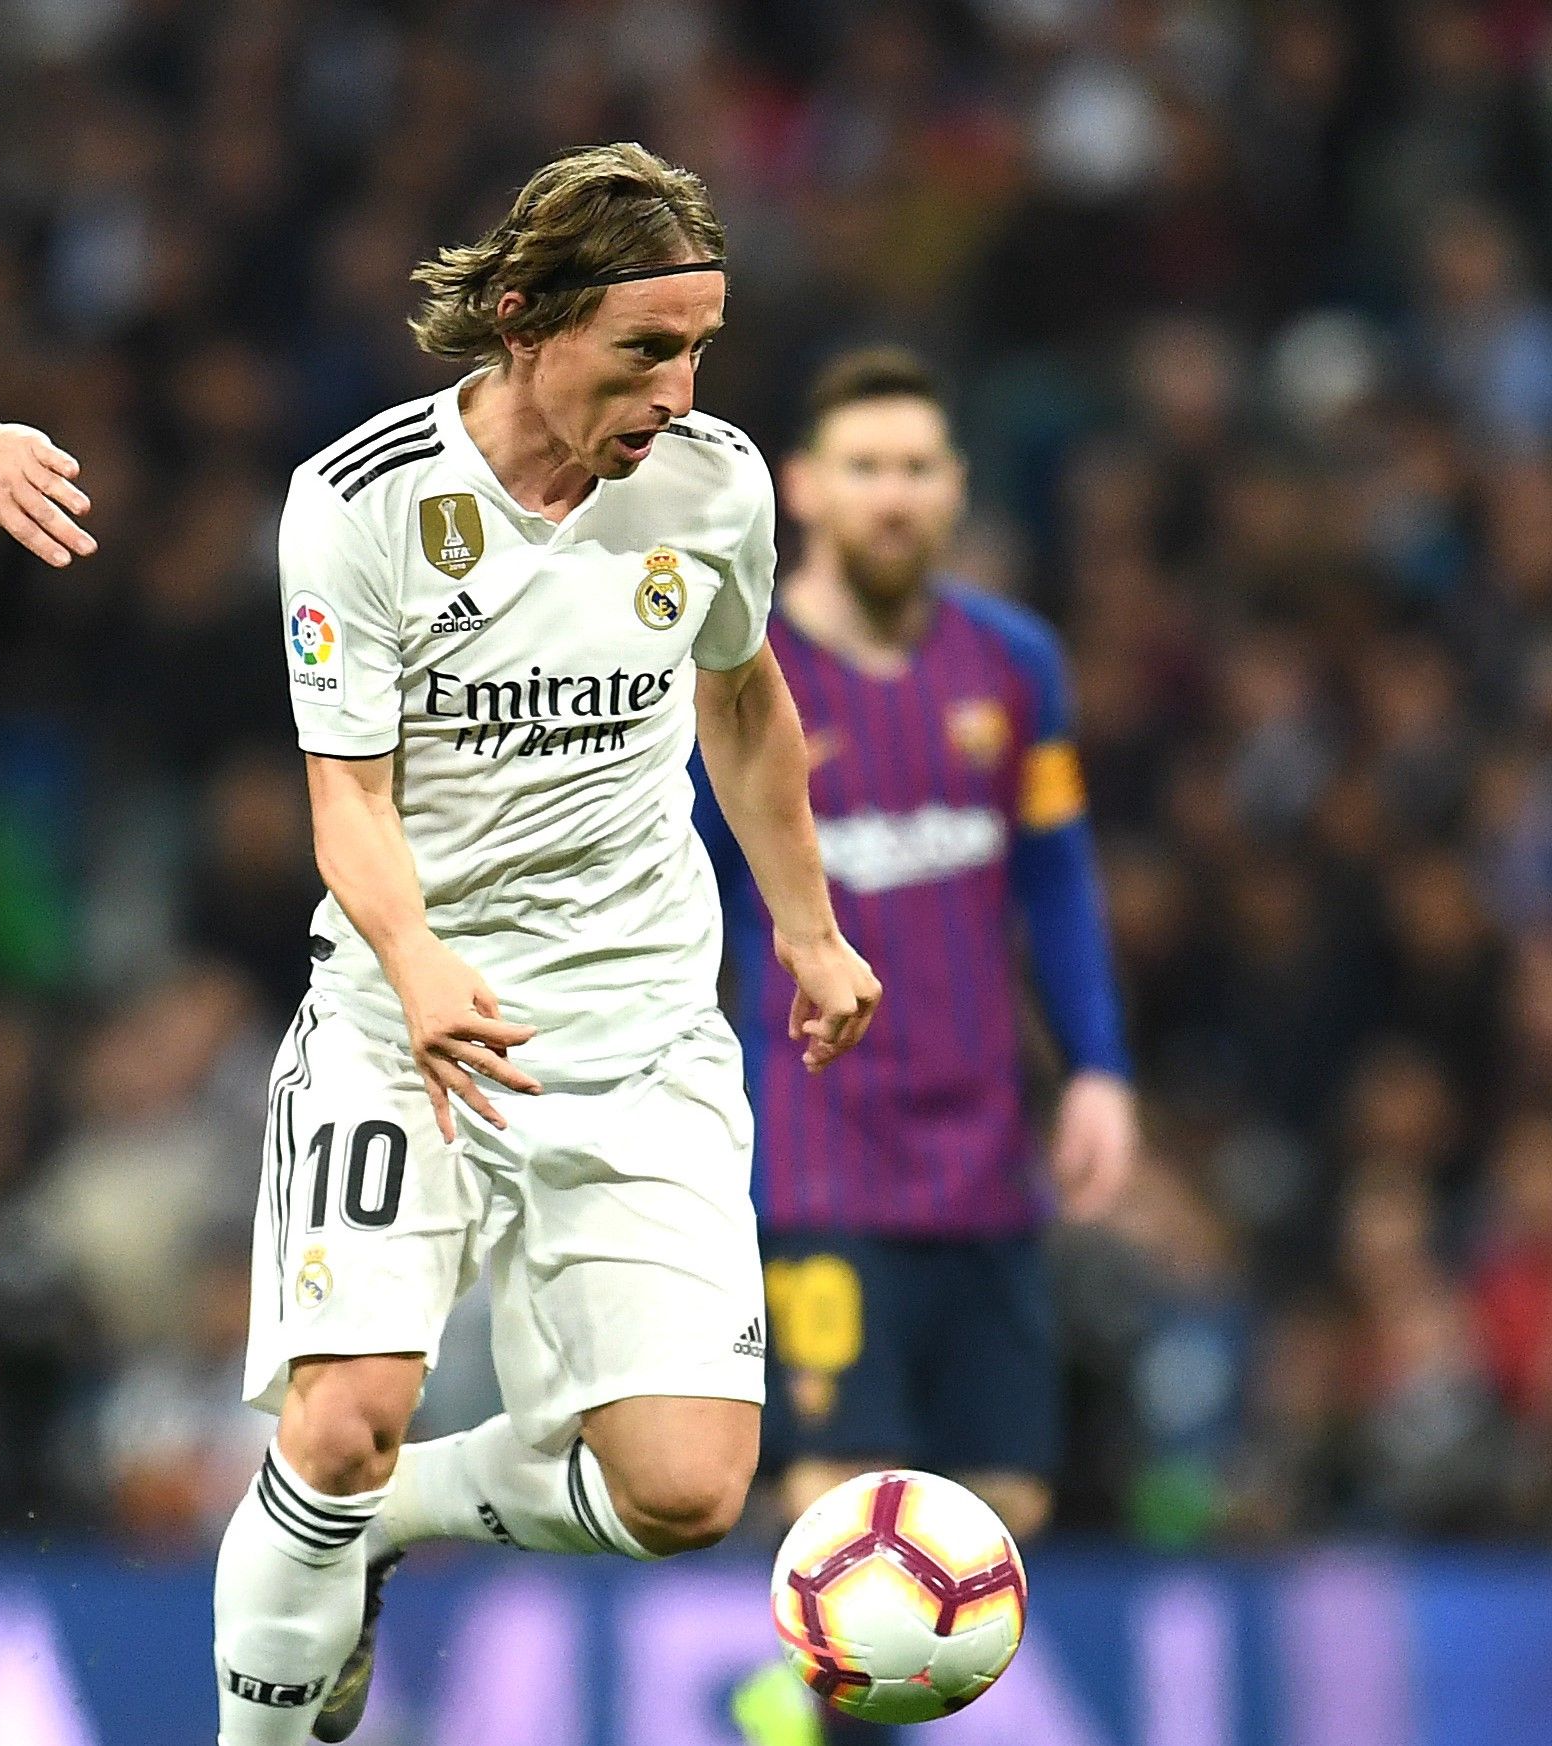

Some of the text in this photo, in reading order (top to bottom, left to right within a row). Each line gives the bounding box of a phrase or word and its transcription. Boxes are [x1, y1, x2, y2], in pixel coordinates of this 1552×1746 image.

[441, 547, 471, 560] FIFA
[293, 669, 337, 691] LaLiga
[425, 666, 674, 721] Emirates
[455, 721, 517, 759] FLY
[303, 1120, 407, 1231] 10
